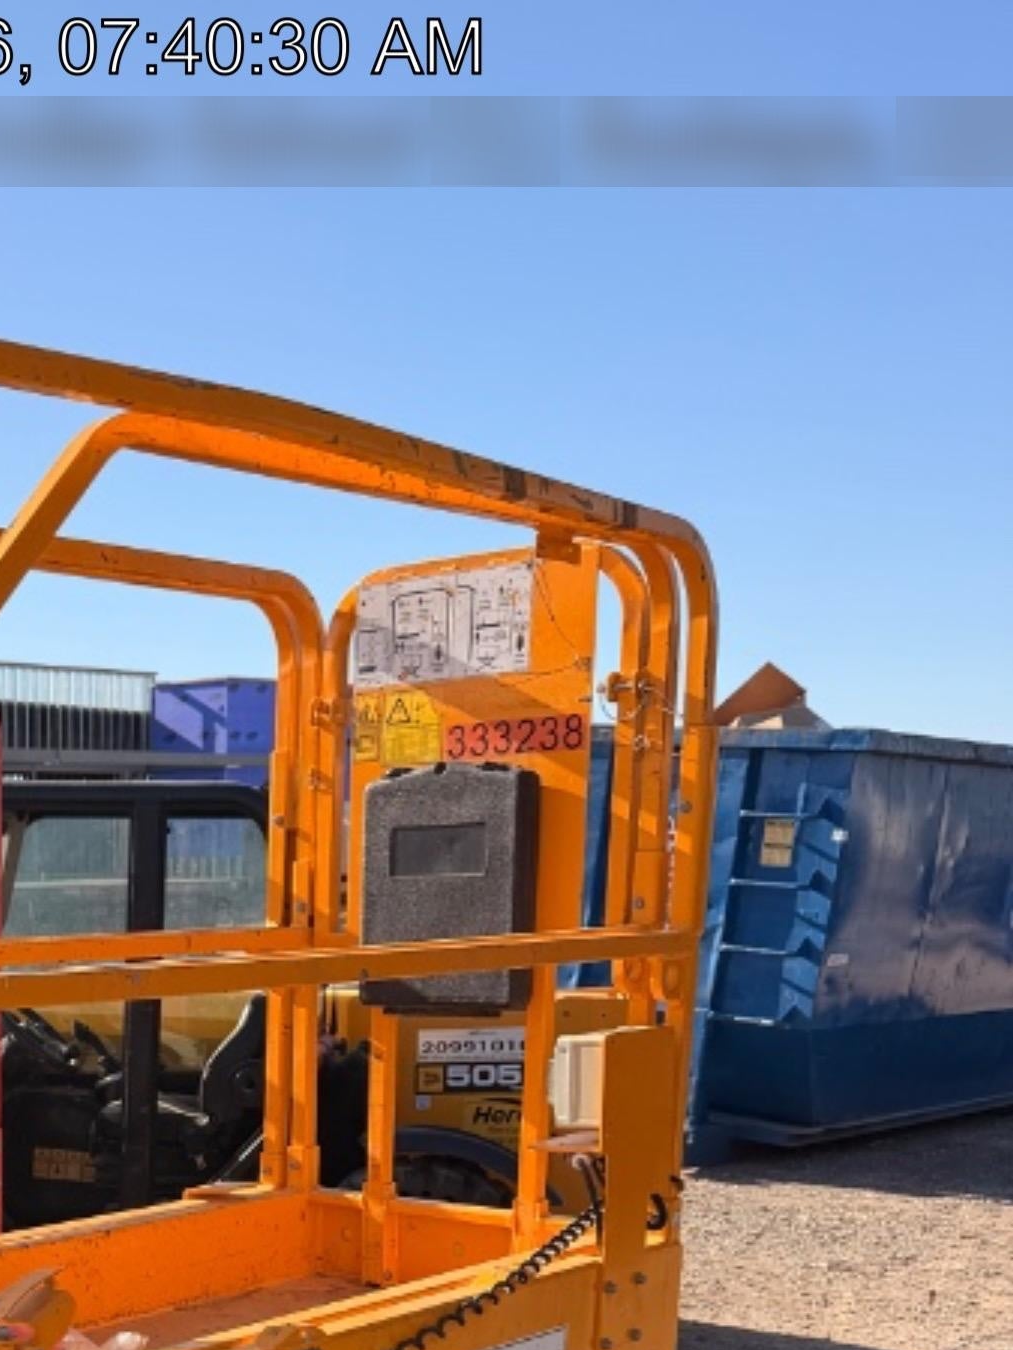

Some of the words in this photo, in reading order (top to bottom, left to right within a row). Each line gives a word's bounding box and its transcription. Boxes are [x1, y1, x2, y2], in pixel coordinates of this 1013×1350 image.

[447, 713, 583, 760] 333238
[445, 1063, 522, 1088] 505
[473, 1105, 522, 1124] Her
